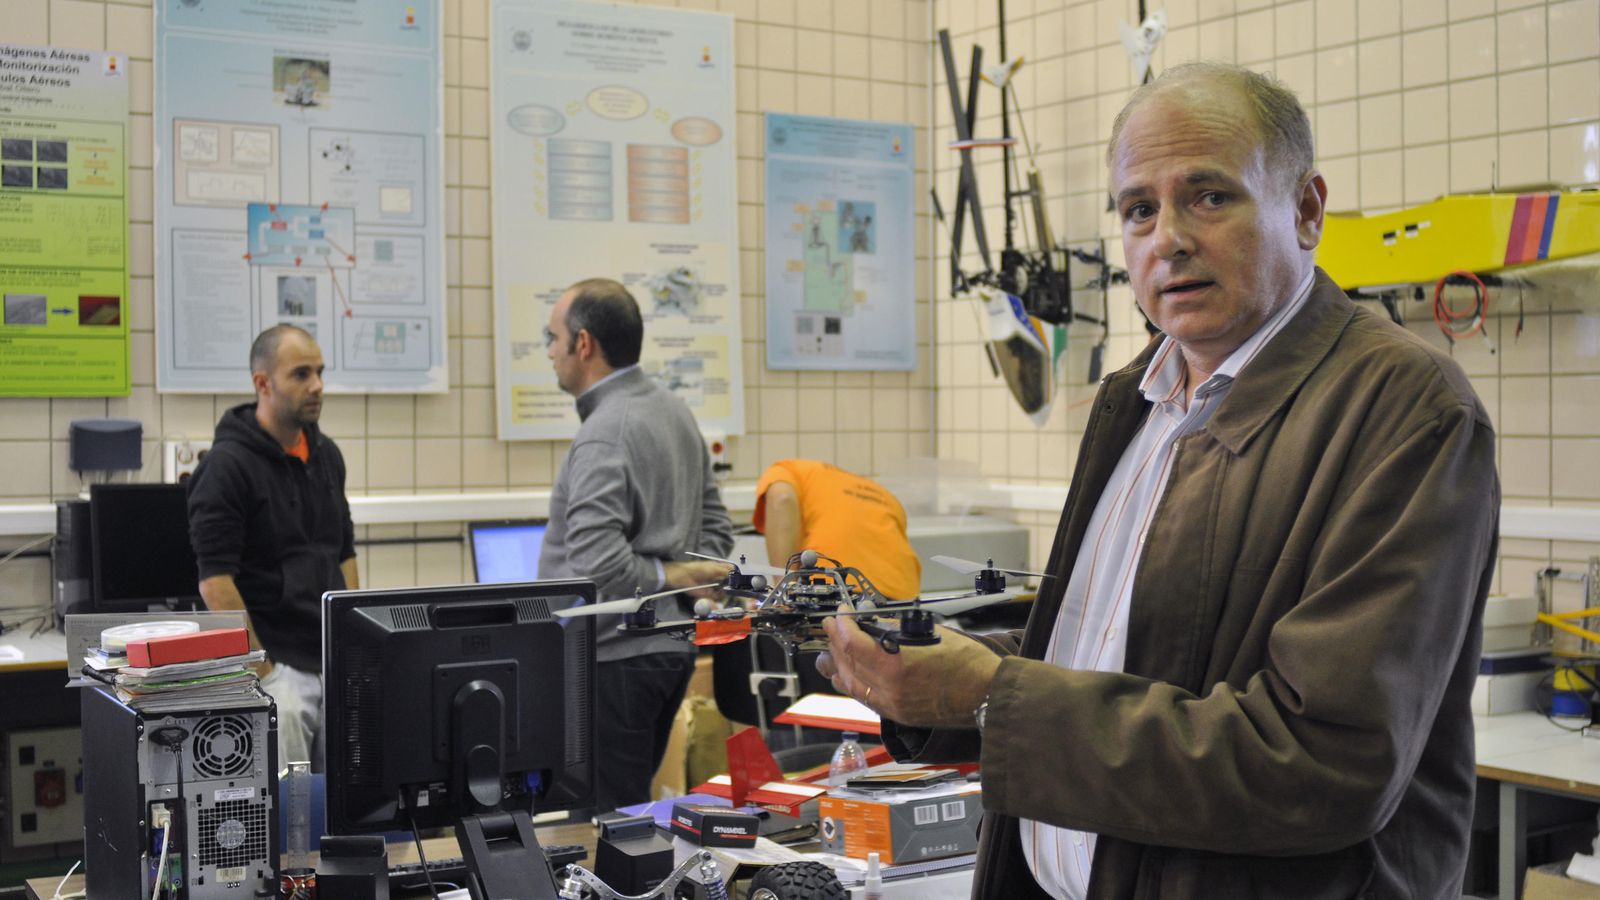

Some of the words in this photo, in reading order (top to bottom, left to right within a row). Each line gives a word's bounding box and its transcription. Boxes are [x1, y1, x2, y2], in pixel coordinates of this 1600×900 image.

[50, 50, 91, 62] Aéreas
[29, 75, 71, 88] Aéreos
[713, 826, 747, 835] DYNAMIXEL
